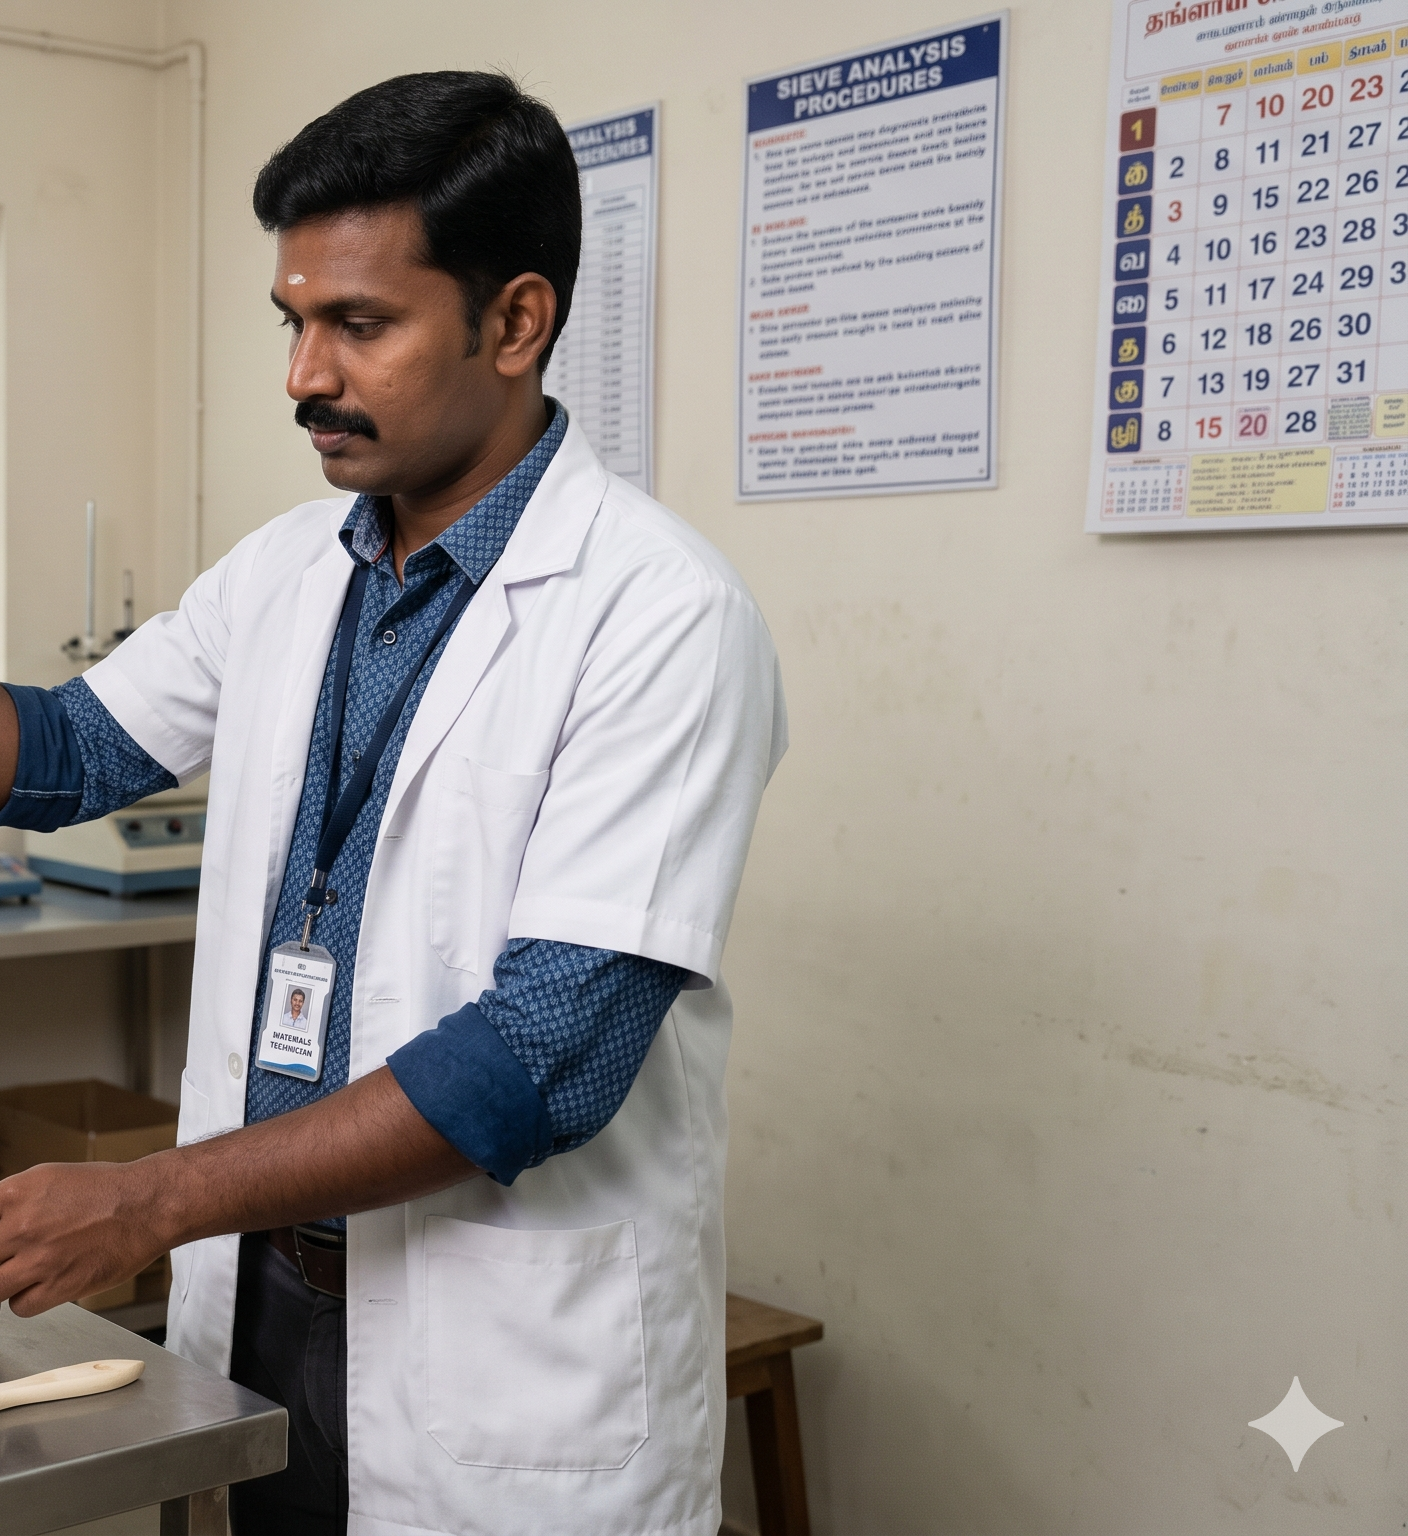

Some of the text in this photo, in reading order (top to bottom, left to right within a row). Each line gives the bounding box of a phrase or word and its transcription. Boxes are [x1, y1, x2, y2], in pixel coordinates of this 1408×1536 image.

[777, 35, 967, 100] SIEVE ANALYSIS
[793, 65, 944, 119] PROCEDURES
[1217, 103, 1232, 126] 7
[1256, 94, 1285, 119] 10
[1301, 84, 1334, 112] 20
[1349, 74, 1384, 102] 23
[1169, 156, 1185, 179] 2
[1214, 148, 1230, 171] 8
[1256, 139, 1280, 164] 11
[1301, 130, 1330, 157] 21
[1347, 121, 1382, 150] 27
[1167, 200, 1183, 223] 3
[1213, 193, 1228, 216] 9
[1252, 185, 1279, 210] 15
[1297, 177, 1330, 204] 22
[1345, 169, 1379, 197] 26
[1166, 244, 1181, 265] 4
[1205, 238, 1232, 262] 10
[1250, 231, 1277, 255] 16
[1294, 224, 1327, 250] 23
[1342, 217, 1376, 244] 28
[1164, 288, 1179, 311] 5
[1204, 283, 1227, 306] 11
[1248, 276, 1276, 301] 17
[1292, 270, 1325, 297] 24
[1340, 264, 1374, 291] 29
[1162, 312, 1372, 355] 6 12 18 26 30
[1160, 359, 1366, 398] 7 13 19 27 31
[1157, 420, 1172, 442] 8
[1195, 416, 1222, 439] 15
[1239, 413, 1268, 437] 20
[1285, 410, 1317, 434] 28
